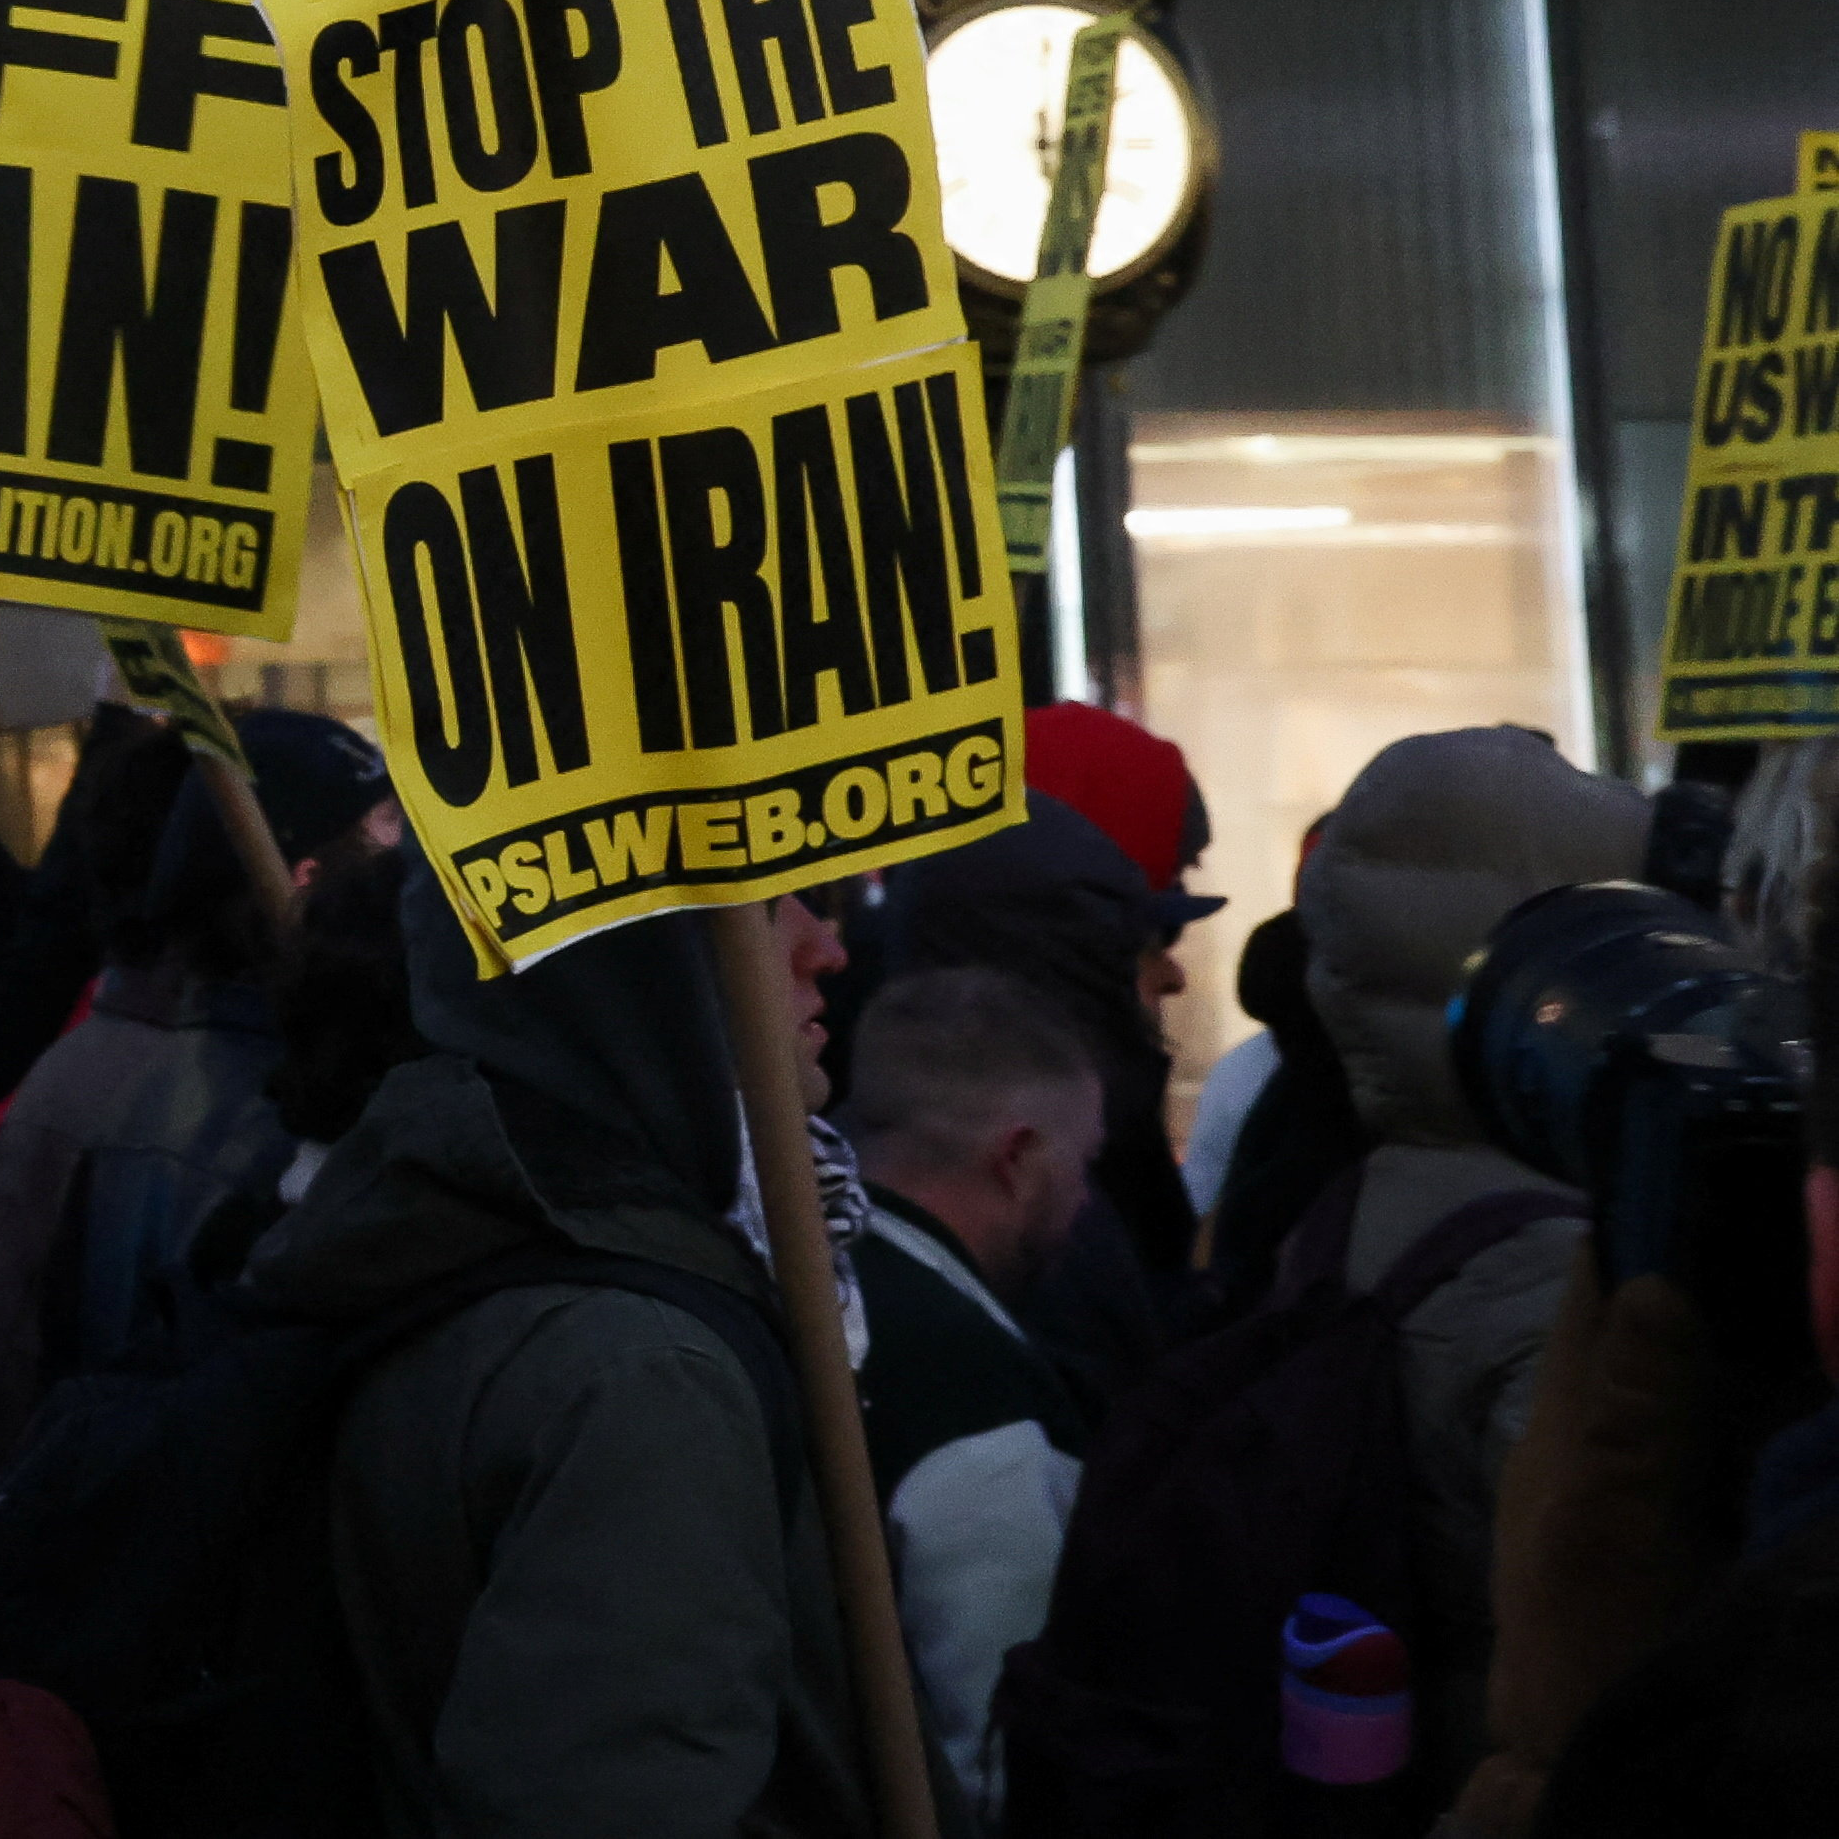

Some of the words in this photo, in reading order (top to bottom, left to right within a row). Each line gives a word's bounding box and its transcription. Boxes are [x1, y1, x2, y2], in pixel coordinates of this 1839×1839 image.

[319, 131, 930, 437] WAR
[1723, 214, 1800, 349] NO
[1701, 352, 1785, 447] US
[382, 453, 591, 808] ON
[607, 369, 999, 754] IRAN!
[1691, 481, 1769, 562] IN
[463, 734, 1005, 928] PSLWEB.ORG
